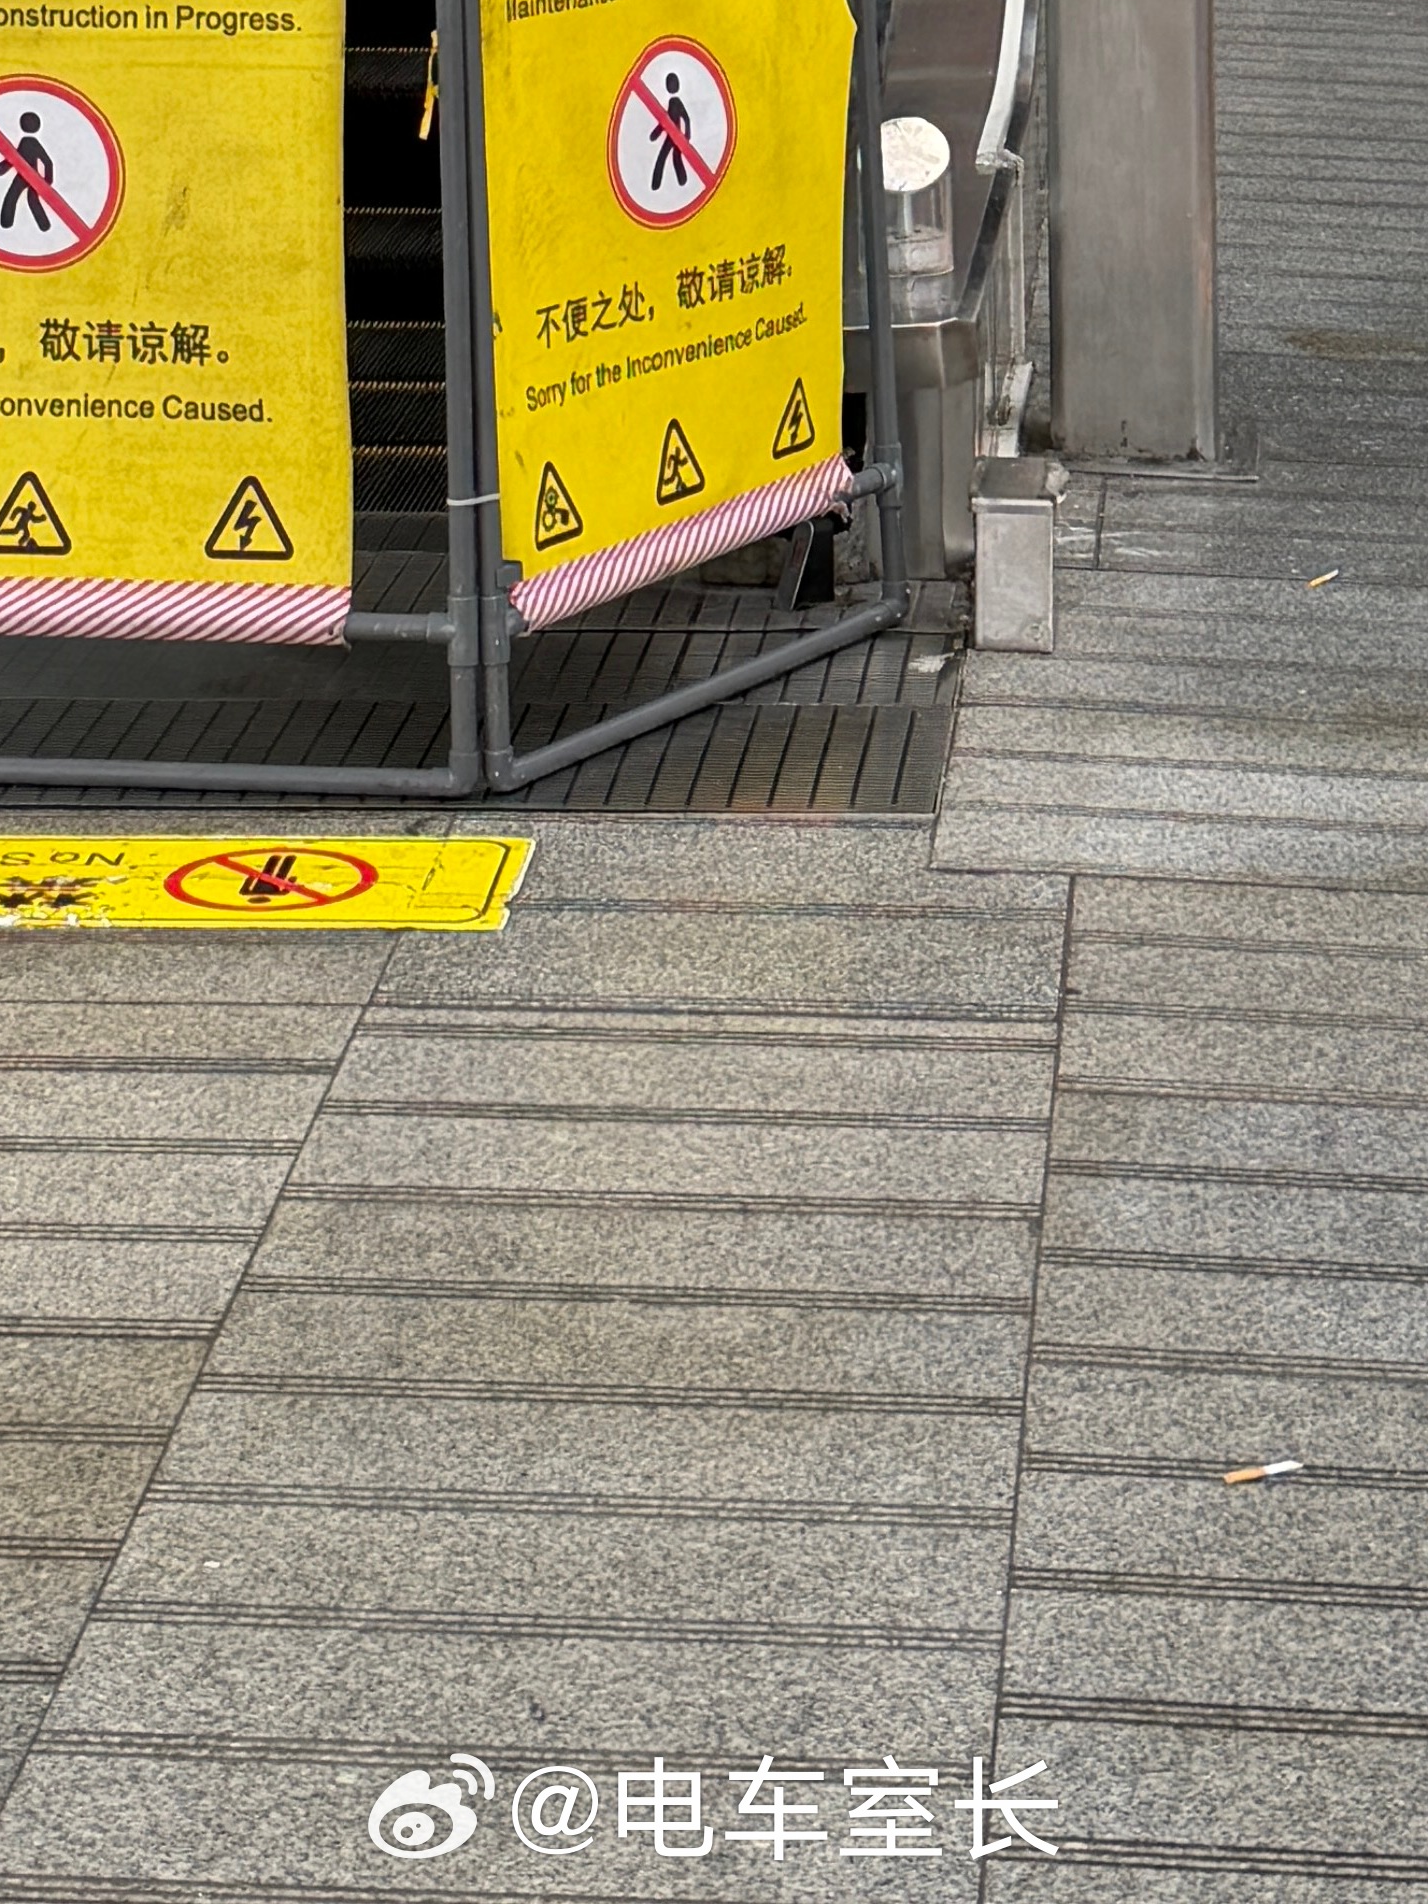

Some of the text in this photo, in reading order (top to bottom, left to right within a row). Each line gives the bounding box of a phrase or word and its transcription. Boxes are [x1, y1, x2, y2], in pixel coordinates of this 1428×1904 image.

[145, 3, 168, 30] in
[176, 5, 303, 36] Progress.
[525, 380, 567, 412] Sorry
[570, 371, 593, 397] for
[595, 362, 622, 388] the
[626, 327, 752, 379] Inconvenience
[162, 394, 273, 423] Caused.
[51, 851, 125, 867] No
